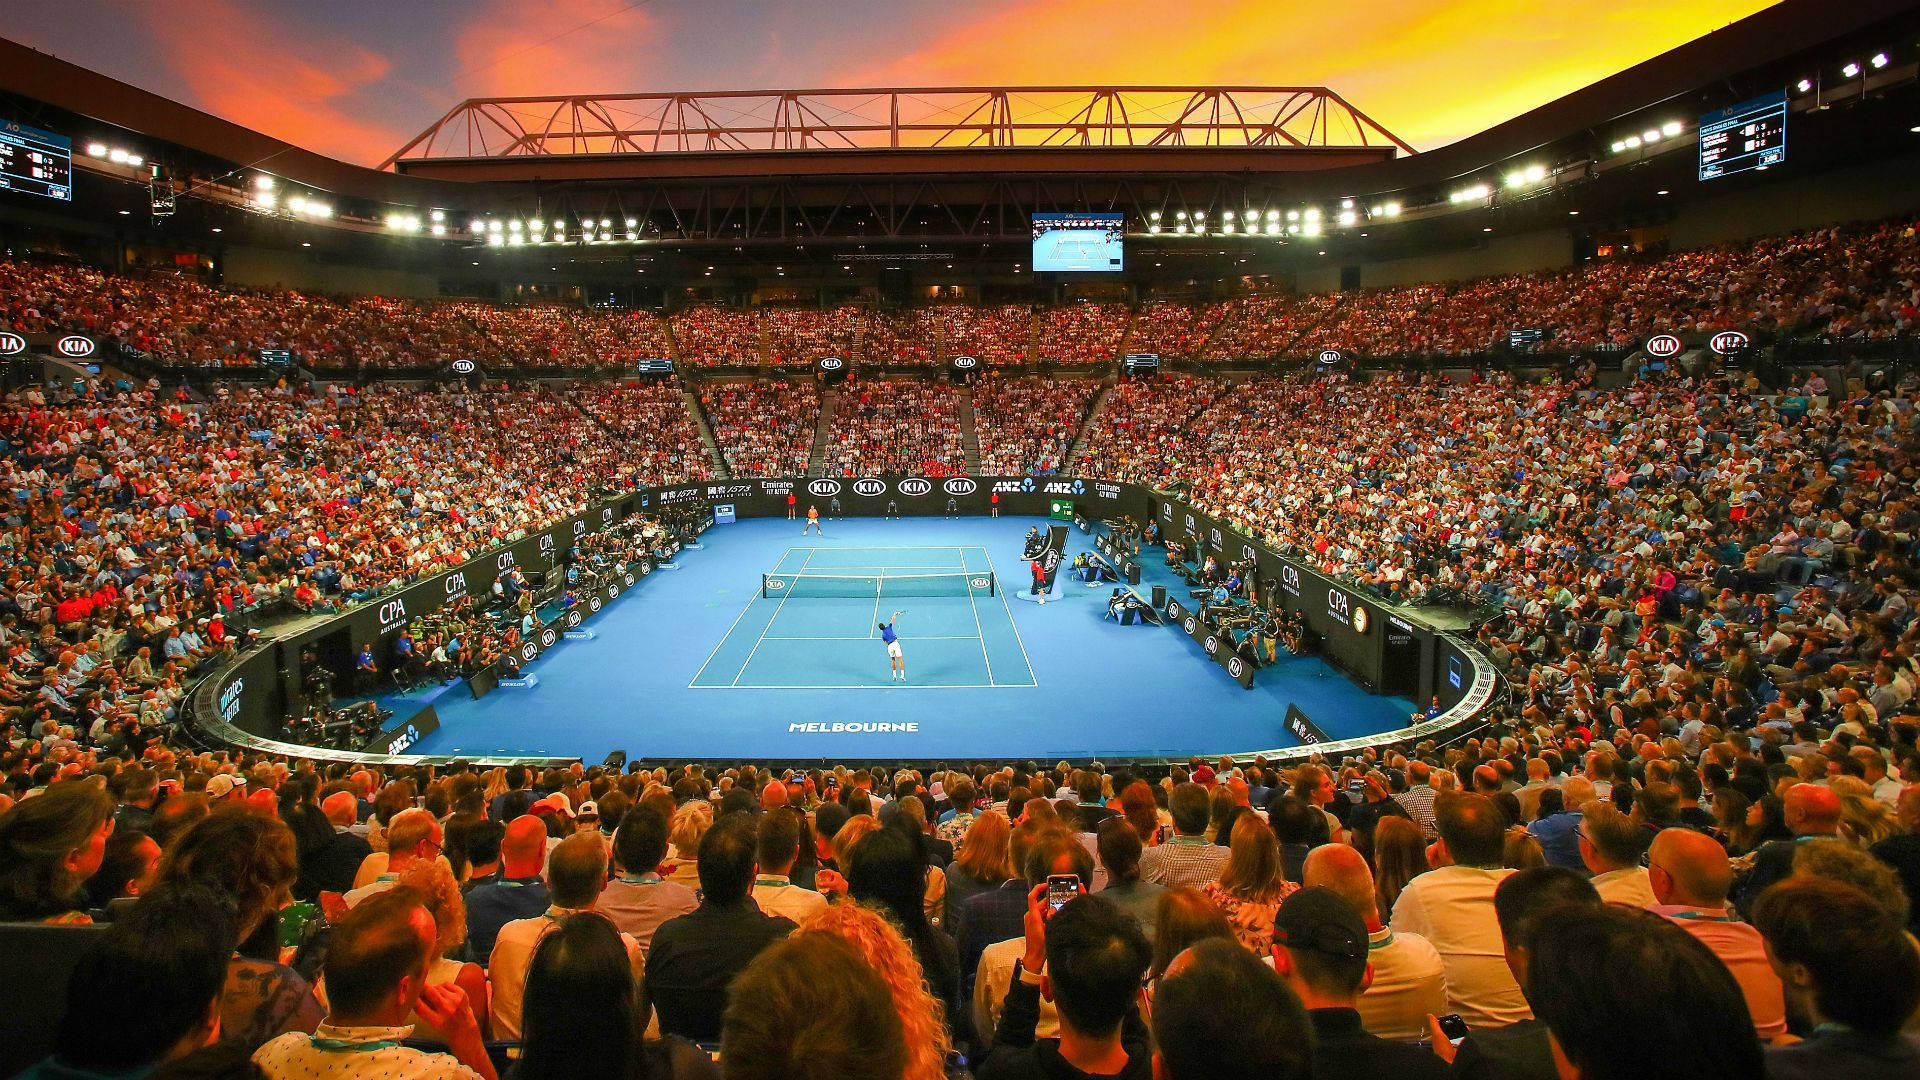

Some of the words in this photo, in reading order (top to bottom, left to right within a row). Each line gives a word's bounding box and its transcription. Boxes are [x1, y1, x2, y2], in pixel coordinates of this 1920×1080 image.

[0, 337, 18, 350] IA
[65, 340, 89, 352] KIA
[1652, 340, 1675, 352] KIA
[1323, 353, 1337, 361] KIA
[456, 362, 471, 370] KIA
[726, 485, 751, 494] 1573
[761, 481, 794, 489] Emirates
[813, 483, 836, 493] KIA
[858, 483, 881, 493] KIA
[904, 482, 926, 492] KIA
[949, 481, 972, 491] KIA
[992, 481, 1020, 492] ANZ
[1043, 482, 1071, 494] ANZ
[1095, 483, 1121, 493] Emirates
[573, 520, 585, 534] CPA
[1185, 514, 1195, 530] CPA
[540, 534, 553, 550] CPA
[1211, 528, 1222, 546] CPA
[497, 551, 514, 570] CPA
[1242, 545, 1256, 565] CPA
[446, 571, 466, 594] CPA
[1283, 565, 1300, 588] CPA
[446, 590, 467, 603] AUSTRALIA
[1328, 589, 1348, 616] CPA
[380, 598, 406, 624] CPA
[1328, 610, 1349, 625] AUSTRALIA
[570, 612, 580, 625] KIA
[380, 619, 407, 635] AUSTRALIA
[543, 631, 555, 645] KIA
[523, 645, 537, 659] KIA
[1230, 660, 1240, 675] KIA
[788, 722, 919, 733] MELBOURNE
[389, 733, 410, 755] ANZ
